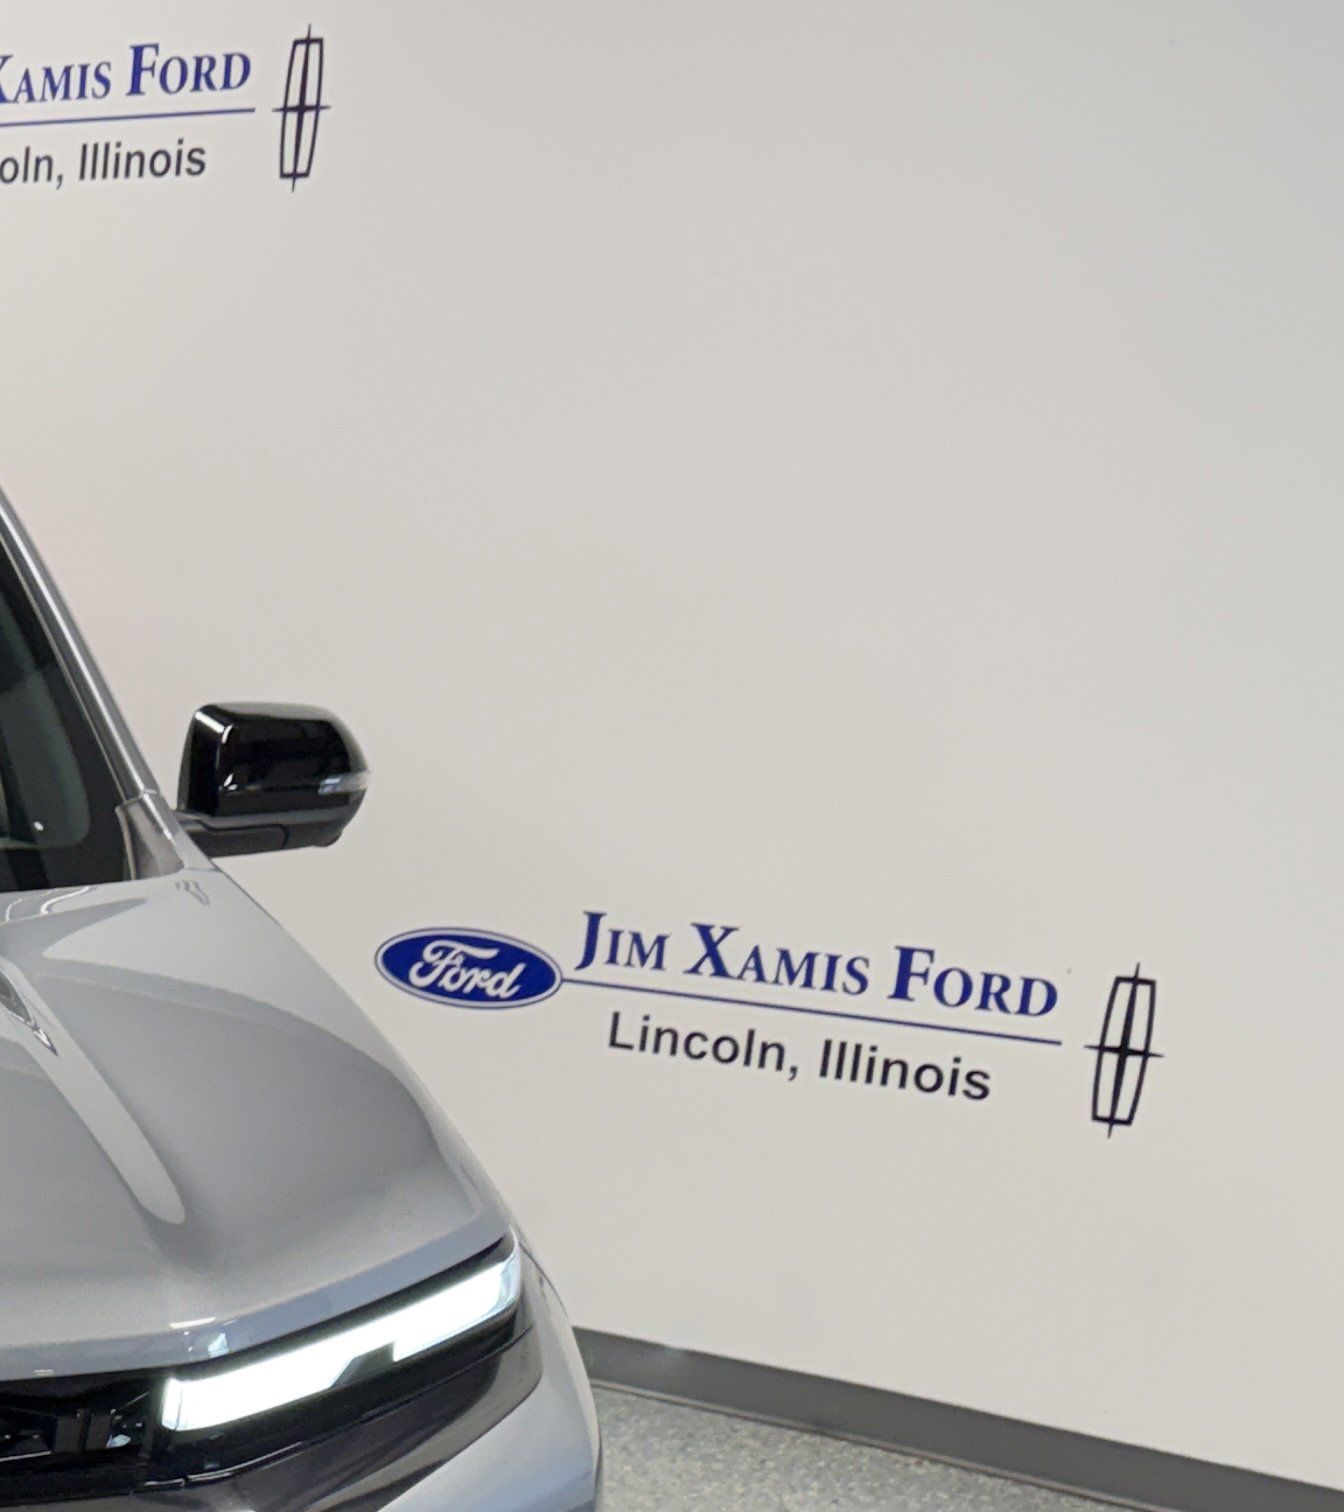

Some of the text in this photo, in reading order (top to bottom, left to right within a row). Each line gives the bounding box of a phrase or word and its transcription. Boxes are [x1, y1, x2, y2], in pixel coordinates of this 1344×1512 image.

[127, 43, 253, 97] FORD
[78, 138, 207, 182] Illinois
[406, 939, 521, 1000] Ford
[574, 910, 1059, 1019] JIM XAMIS FORD
[607, 1011, 992, 1101] Lincoln, Illinois
